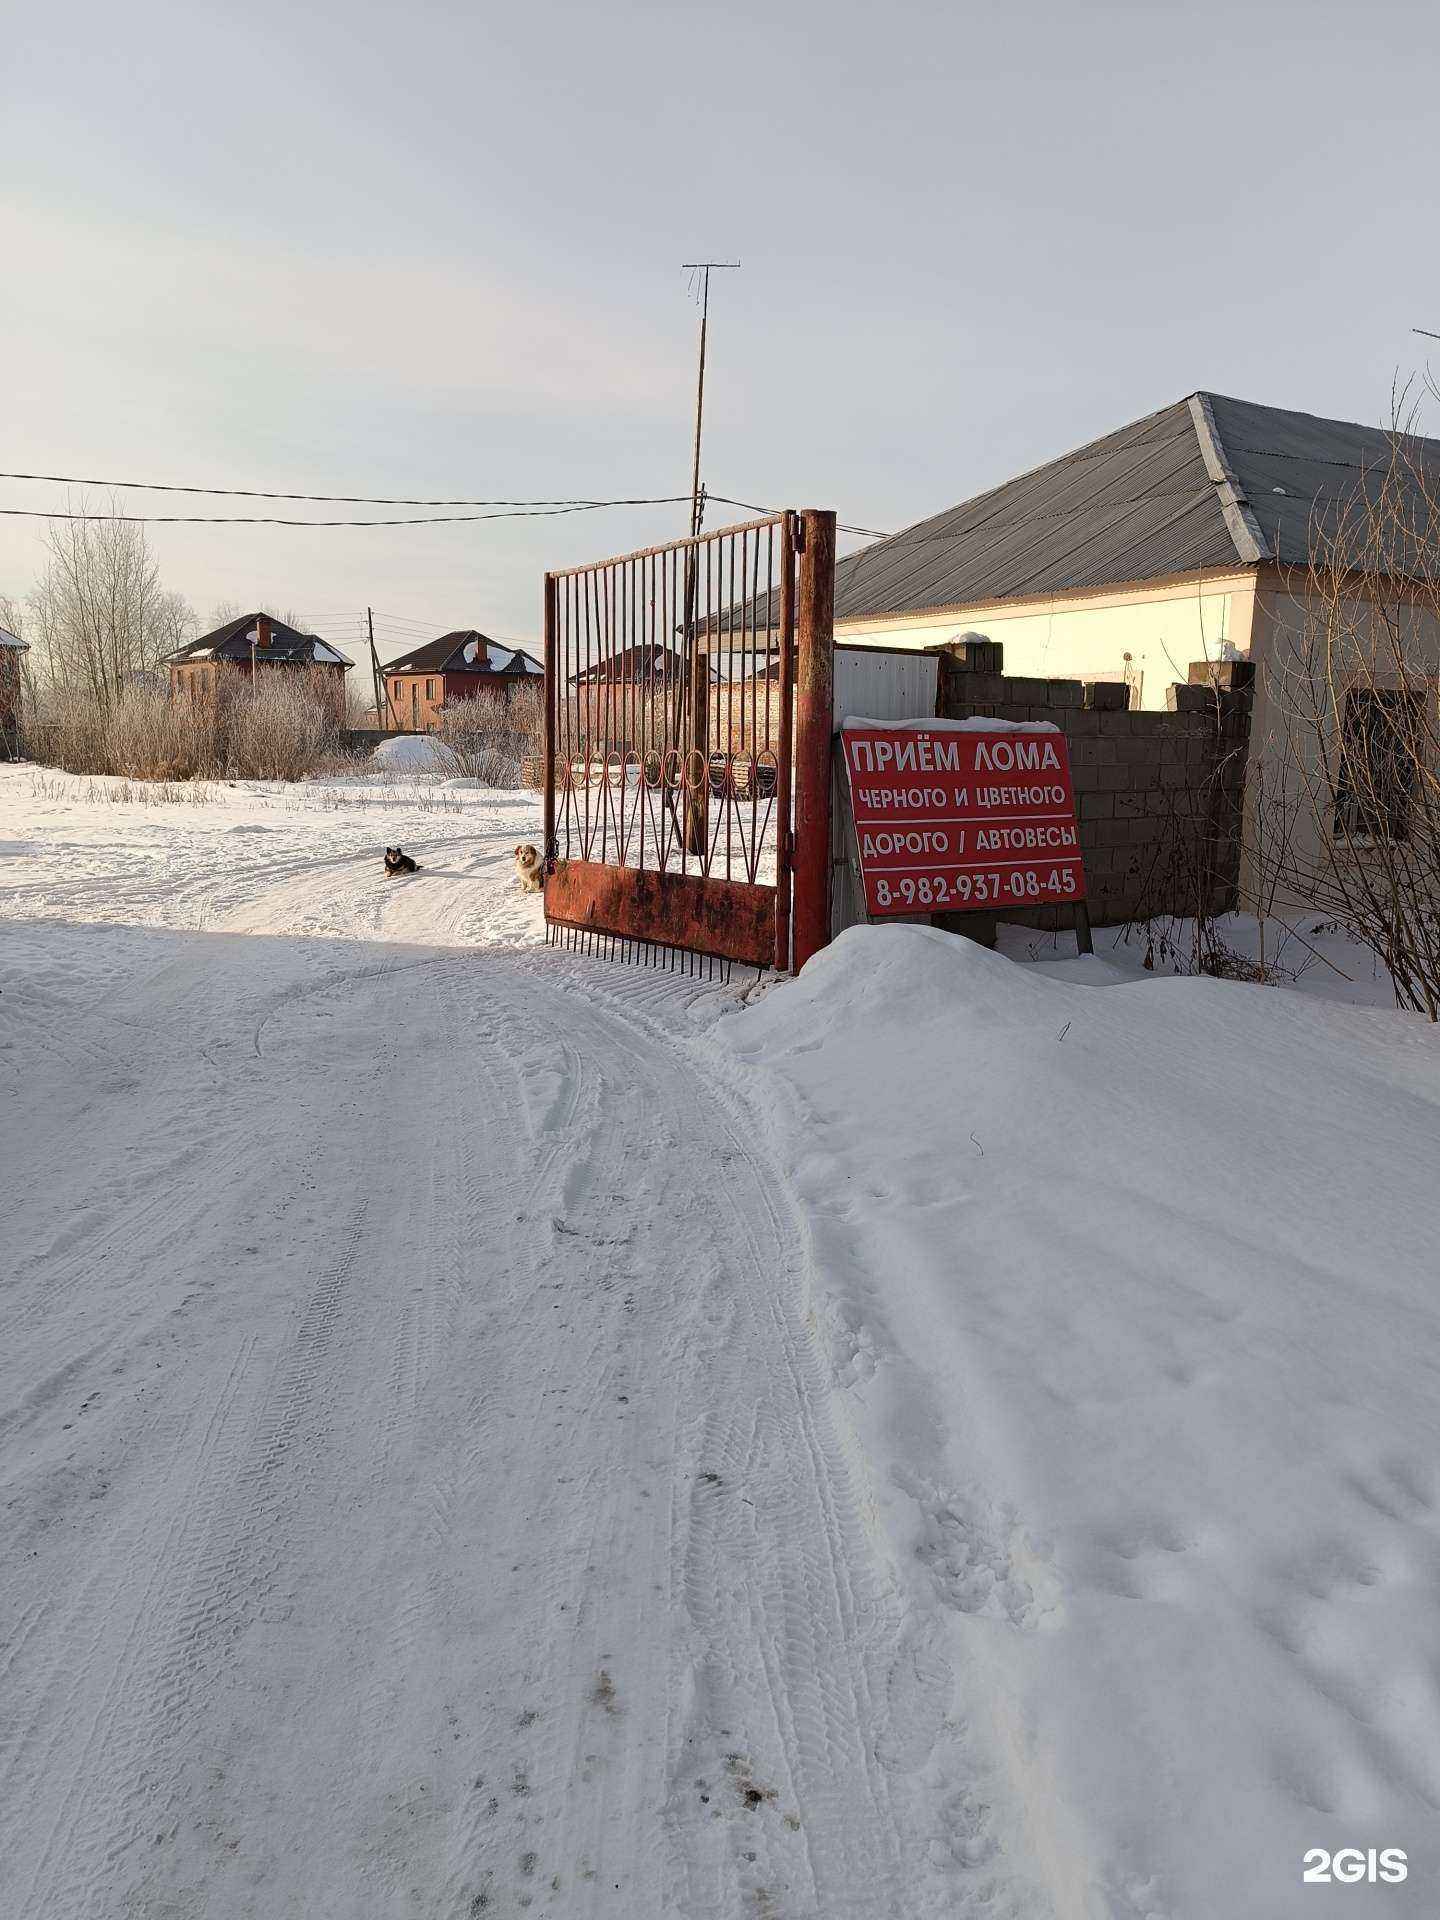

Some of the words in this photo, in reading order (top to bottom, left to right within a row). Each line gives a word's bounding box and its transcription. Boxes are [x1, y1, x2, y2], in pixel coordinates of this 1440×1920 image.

[851, 734, 960, 772] ПРИЁМ
[974, 741, 1061, 771] ЛОМА
[859, 787, 947, 808] ЧЕРНОГО
[955, 788, 969, 807] И
[976, 785, 1066, 808] ЦВЕТНОГО
[863, 831, 949, 858] ДОРОГО
[976, 826, 1077, 850] АВТОВЕСЫ
[876, 868, 1077, 906] 8-982-937-08-45
